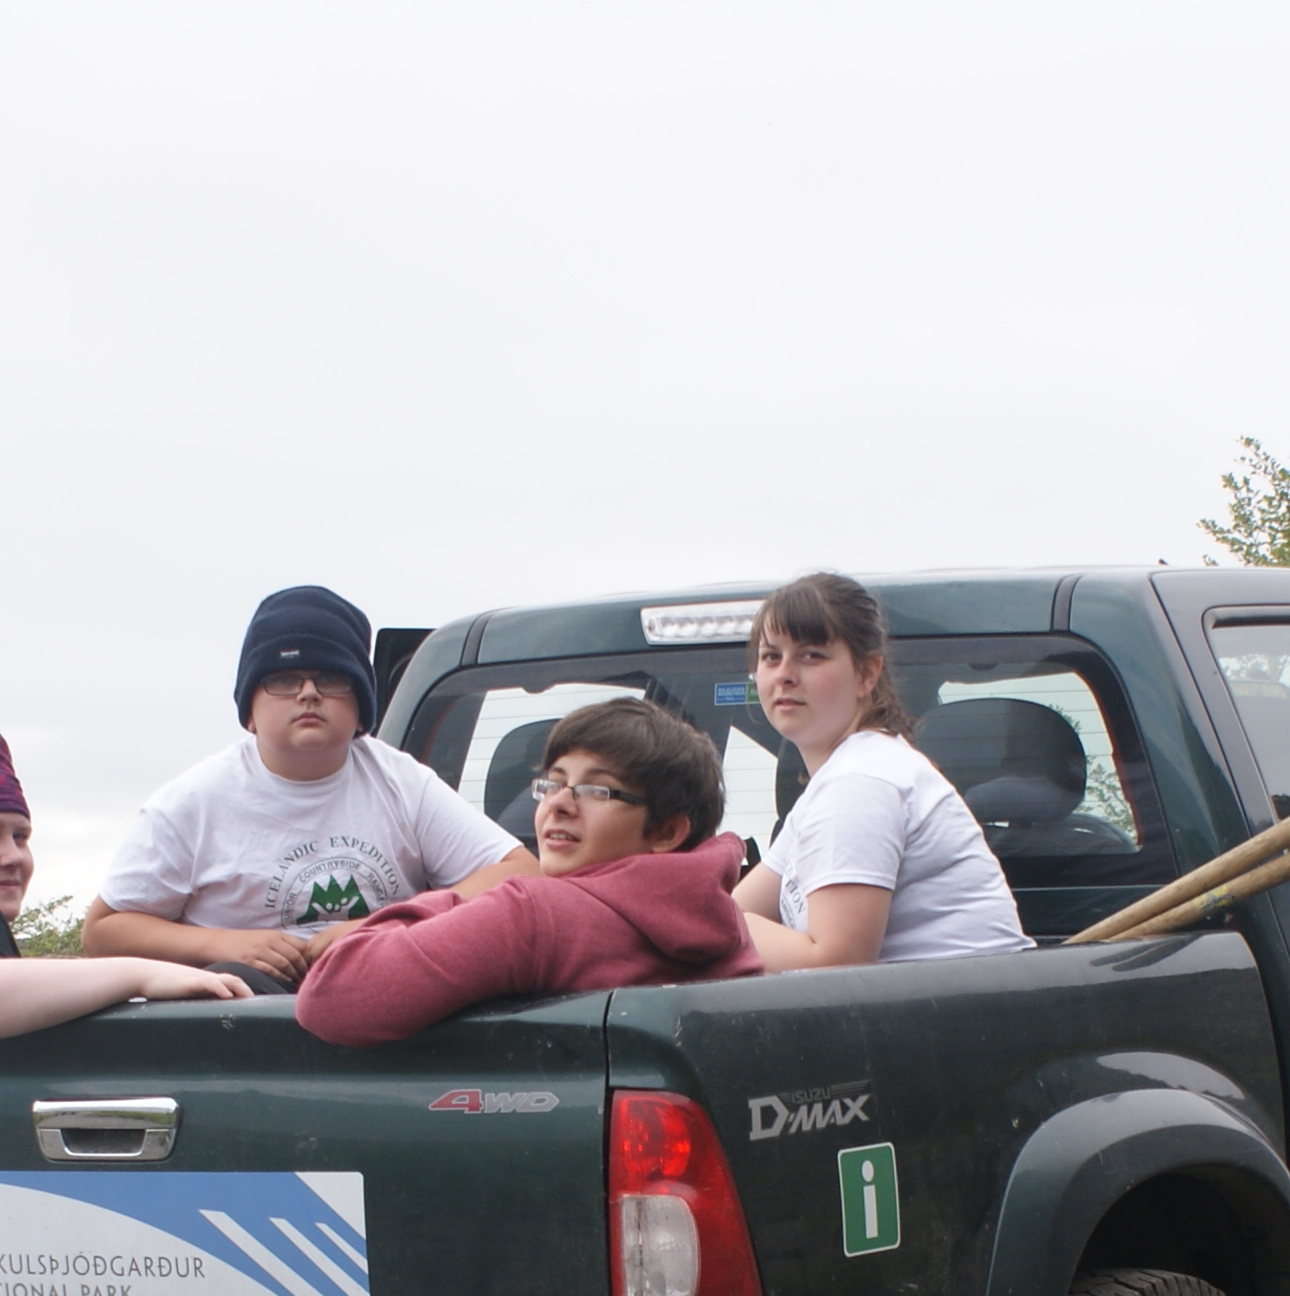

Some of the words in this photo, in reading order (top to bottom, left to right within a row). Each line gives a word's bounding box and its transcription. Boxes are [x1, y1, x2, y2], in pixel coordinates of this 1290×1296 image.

[264, 840, 318, 909] ICELANDIC
[329, 836, 402, 896] EXPEDITION
[298, 859, 361, 884] COUNTRYSIDE
[429, 1089, 560, 1114] 4WD
[792, 1087, 832, 1105] ISUZU
